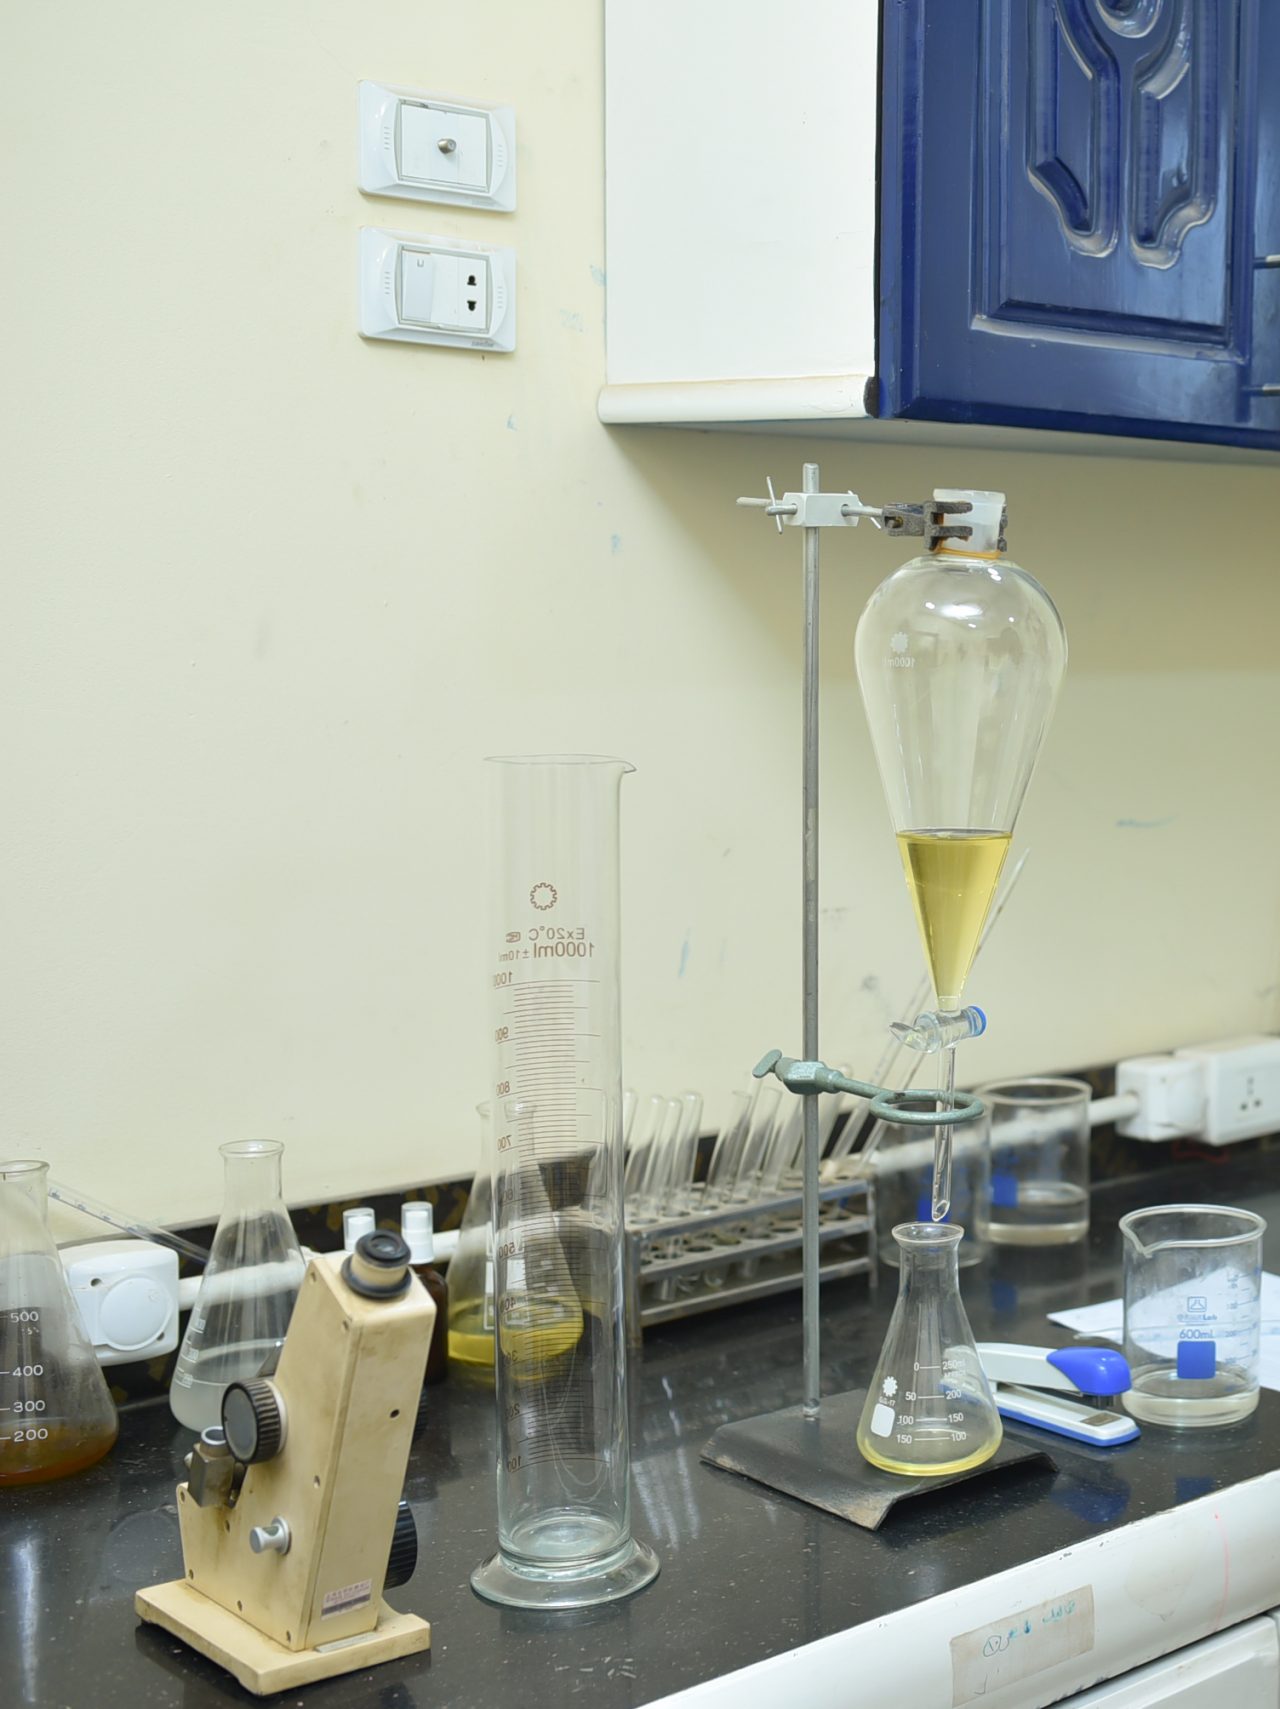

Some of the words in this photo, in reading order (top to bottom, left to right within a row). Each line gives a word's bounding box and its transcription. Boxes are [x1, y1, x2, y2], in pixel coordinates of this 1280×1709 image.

[10, 1311, 39, 1323] 500
[12, 1364, 44, 1377] 400
[913, 1361, 920, 1371] 0
[905, 1391, 917, 1401] 50
[945, 1390, 962, 1400] 200
[13, 1400, 46, 1413] 300
[898, 1415, 914, 1425] 100
[948, 1412, 964, 1423] 150
[13, 1428, 48, 1442] 200
[896, 1434, 912, 1444] 150
[951, 1431, 967, 1442] 100
